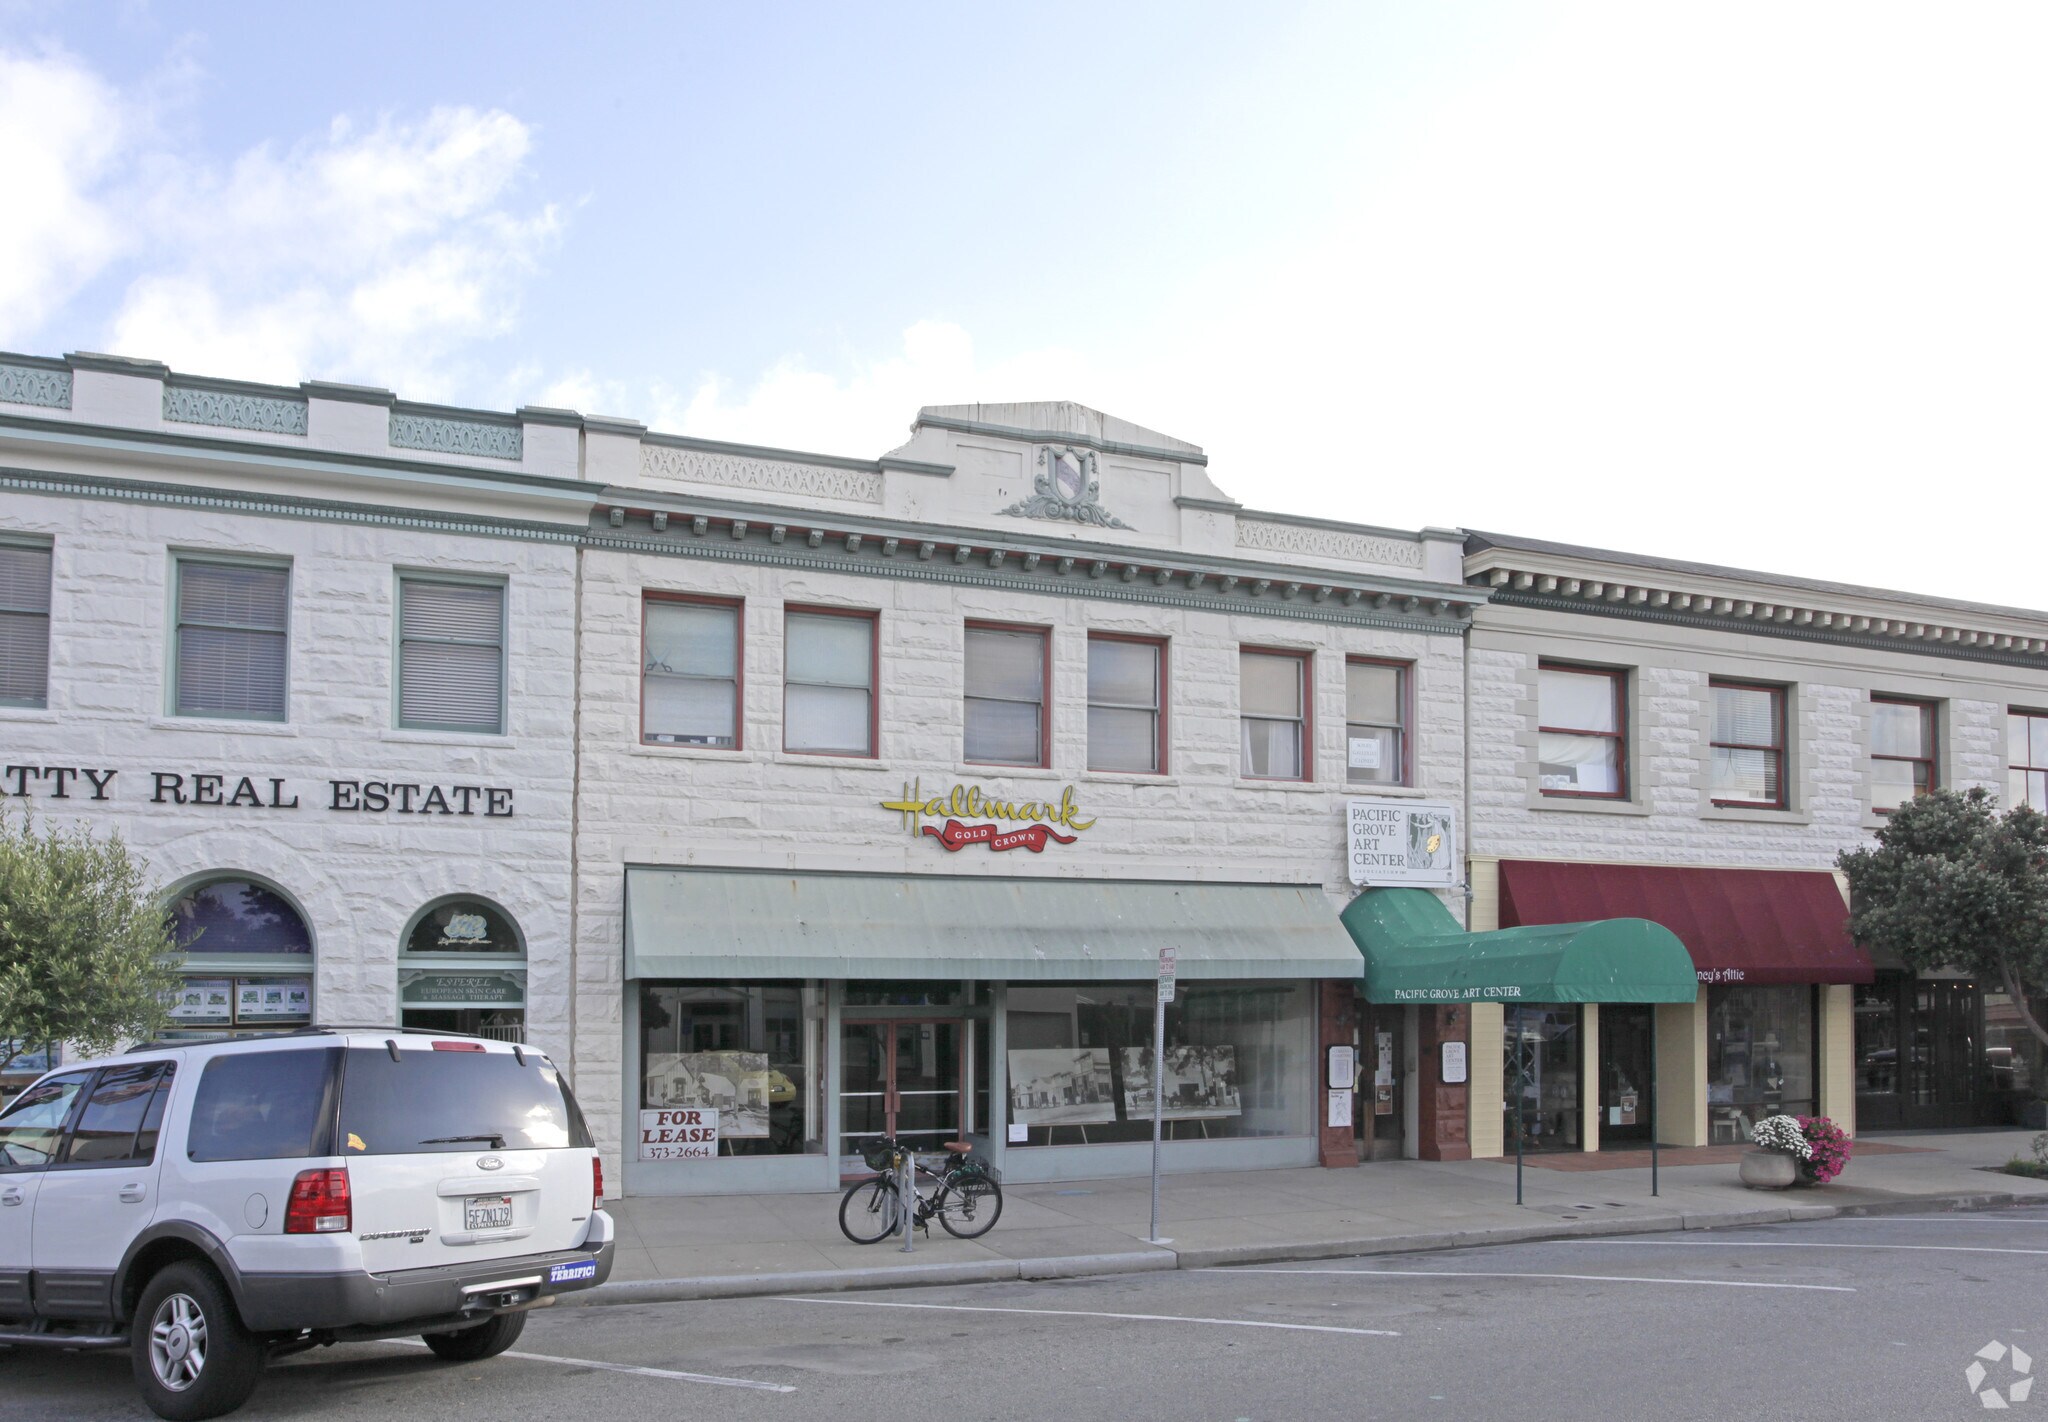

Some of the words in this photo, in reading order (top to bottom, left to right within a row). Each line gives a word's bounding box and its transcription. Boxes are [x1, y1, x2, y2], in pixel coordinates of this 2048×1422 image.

[0, 765, 118, 800] TTY
[150, 772, 299, 808] REAL
[328, 780, 514, 817] ESTATE
[879, 776, 1098, 838] Hallmark
[1352, 808, 1401, 822] PACIFIC
[1352, 823, 1397, 837] GROVE
[954, 829, 988, 839] GOLD
[994, 833, 1036, 847] CROWN
[1353, 838, 1380, 851] ART
[1353, 852, 1405, 867] CENTER
[1722, 967, 1745, 982] Attic
[436, 978, 491, 987] ESTEREL
[1395, 989, 1428, 999] PACIFIC
[1429, 988, 1460, 999] GROVE
[1462, 987, 1481, 998] ART
[1483, 986, 1521, 997] CENTER
[656, 1111, 702, 1126] FOR
[642, 1128, 716, 1144] LEASE
[649, 1146, 709, 1159] 373-2664
[469, 1207, 510, 1224] 5FZN179
[551, 1265, 596, 1282] TERRIFIC!
